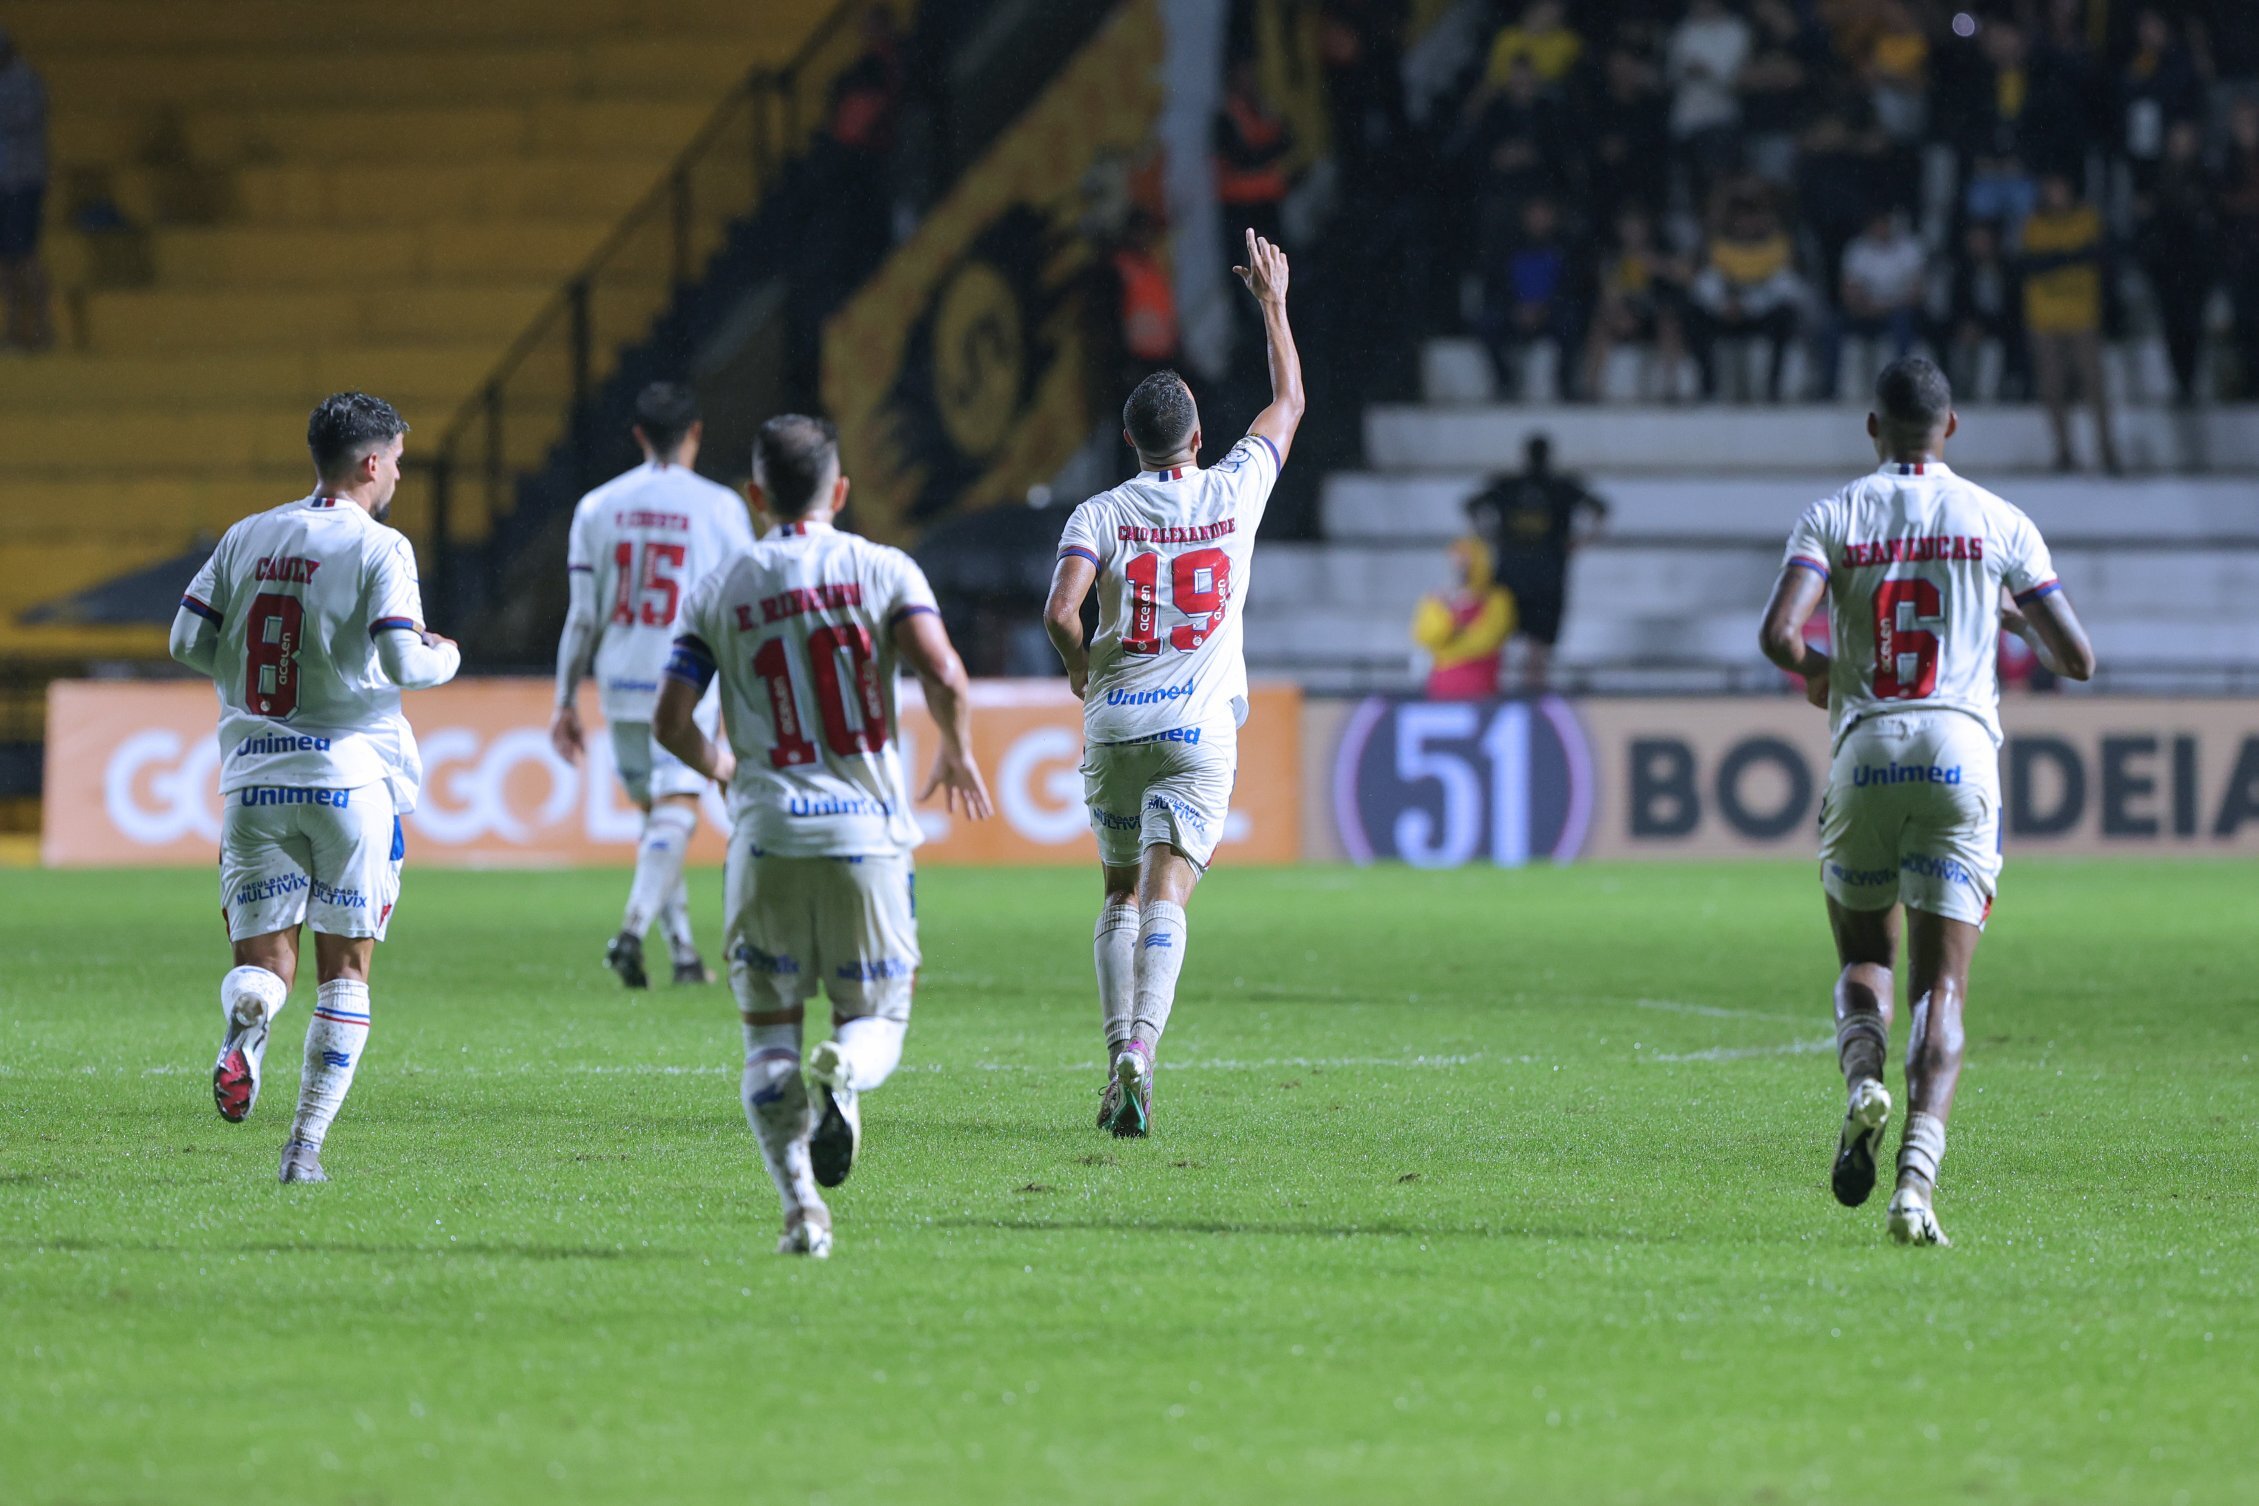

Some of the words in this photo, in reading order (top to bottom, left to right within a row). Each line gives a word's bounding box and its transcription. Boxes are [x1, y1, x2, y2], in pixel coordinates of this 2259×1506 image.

[1150, 518, 1236, 543] ALEXANDRE
[1843, 538, 1904, 568] JEAN
[1907, 535, 1983, 561] LUCAS
[255, 556, 321, 585] CAULY
[612, 543, 685, 625] 15
[1122, 547, 1233, 658] 19
[1139, 584, 1151, 632] acelen
[1872, 578, 1945, 699] 6
[246, 593, 306, 722] 8
[278, 632, 292, 686] acelen
[753, 622, 888, 769] 10
[1107, 678, 1194, 706] Unimed
[1396, 701, 1533, 868] 51
[1629, 735, 1814, 841] BO
[2010, 735, 2259, 841] DEIA
[1853, 761, 1962, 788] Unimed
[241, 786, 350, 809] Unimed
[1148, 799, 1209, 833] MUTIVIX
[236, 875, 309, 906] MULTIVIX
[242, 872, 296, 891] FACULDADE
[313, 879, 359, 896] ACULDADE
[313, 887, 368, 908] ULTIVIX
